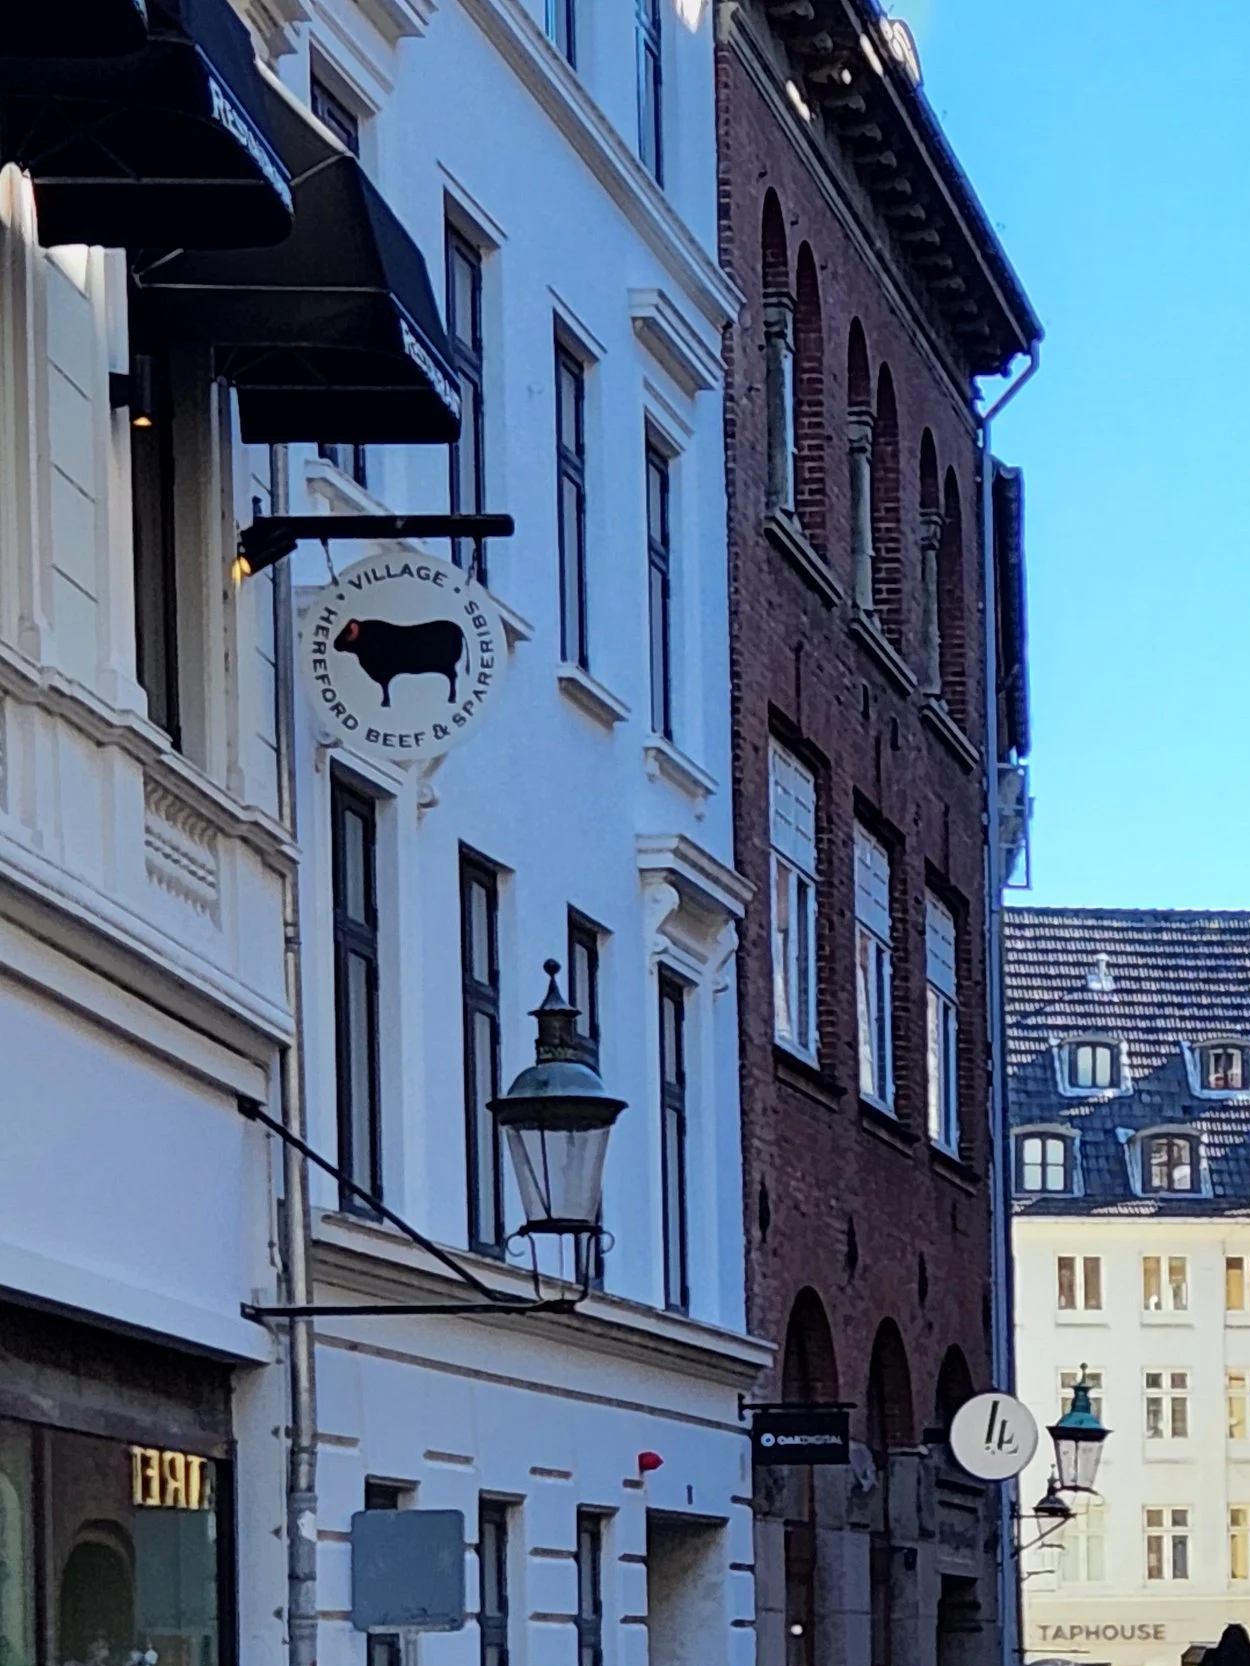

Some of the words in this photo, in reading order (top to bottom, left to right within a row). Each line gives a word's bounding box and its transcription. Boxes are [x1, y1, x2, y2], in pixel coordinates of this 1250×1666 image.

[347, 563, 448, 591] VILLAGE
[312, 606, 359, 731] HEREFORD
[365, 727, 426, 748] BEEF
[432, 723, 451, 741] &
[452, 600, 496, 728] SPARERIBS
[1037, 1624, 1167, 1641] TAPHOUSE
